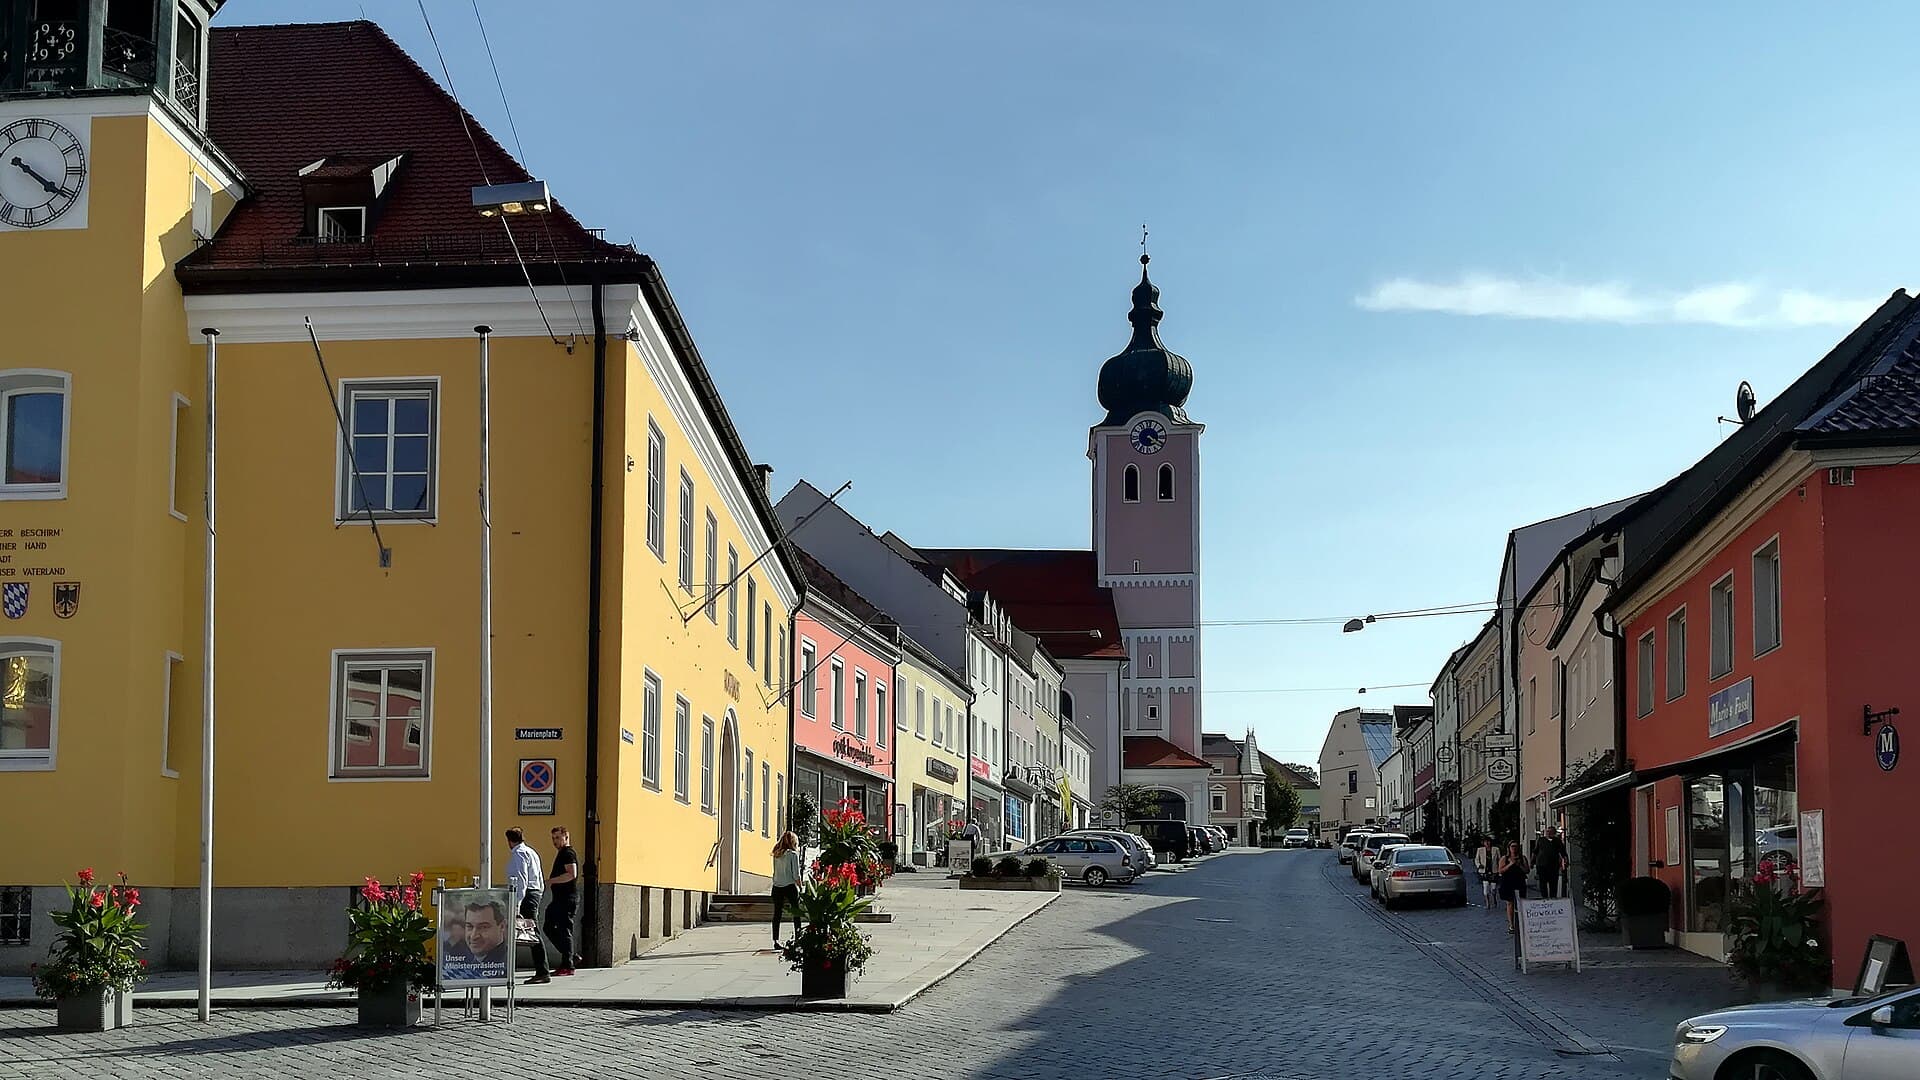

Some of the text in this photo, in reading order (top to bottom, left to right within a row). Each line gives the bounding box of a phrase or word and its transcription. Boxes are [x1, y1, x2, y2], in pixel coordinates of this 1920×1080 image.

[25, 542, 47, 550] HAND
[22, 567, 66, 576] VATERLAND
[520, 729, 558, 739] Marienplatz
[1881, 732, 1894, 753] M
[445, 954, 466, 962] Unser
[445, 961, 505, 970] Ministerpräsident
